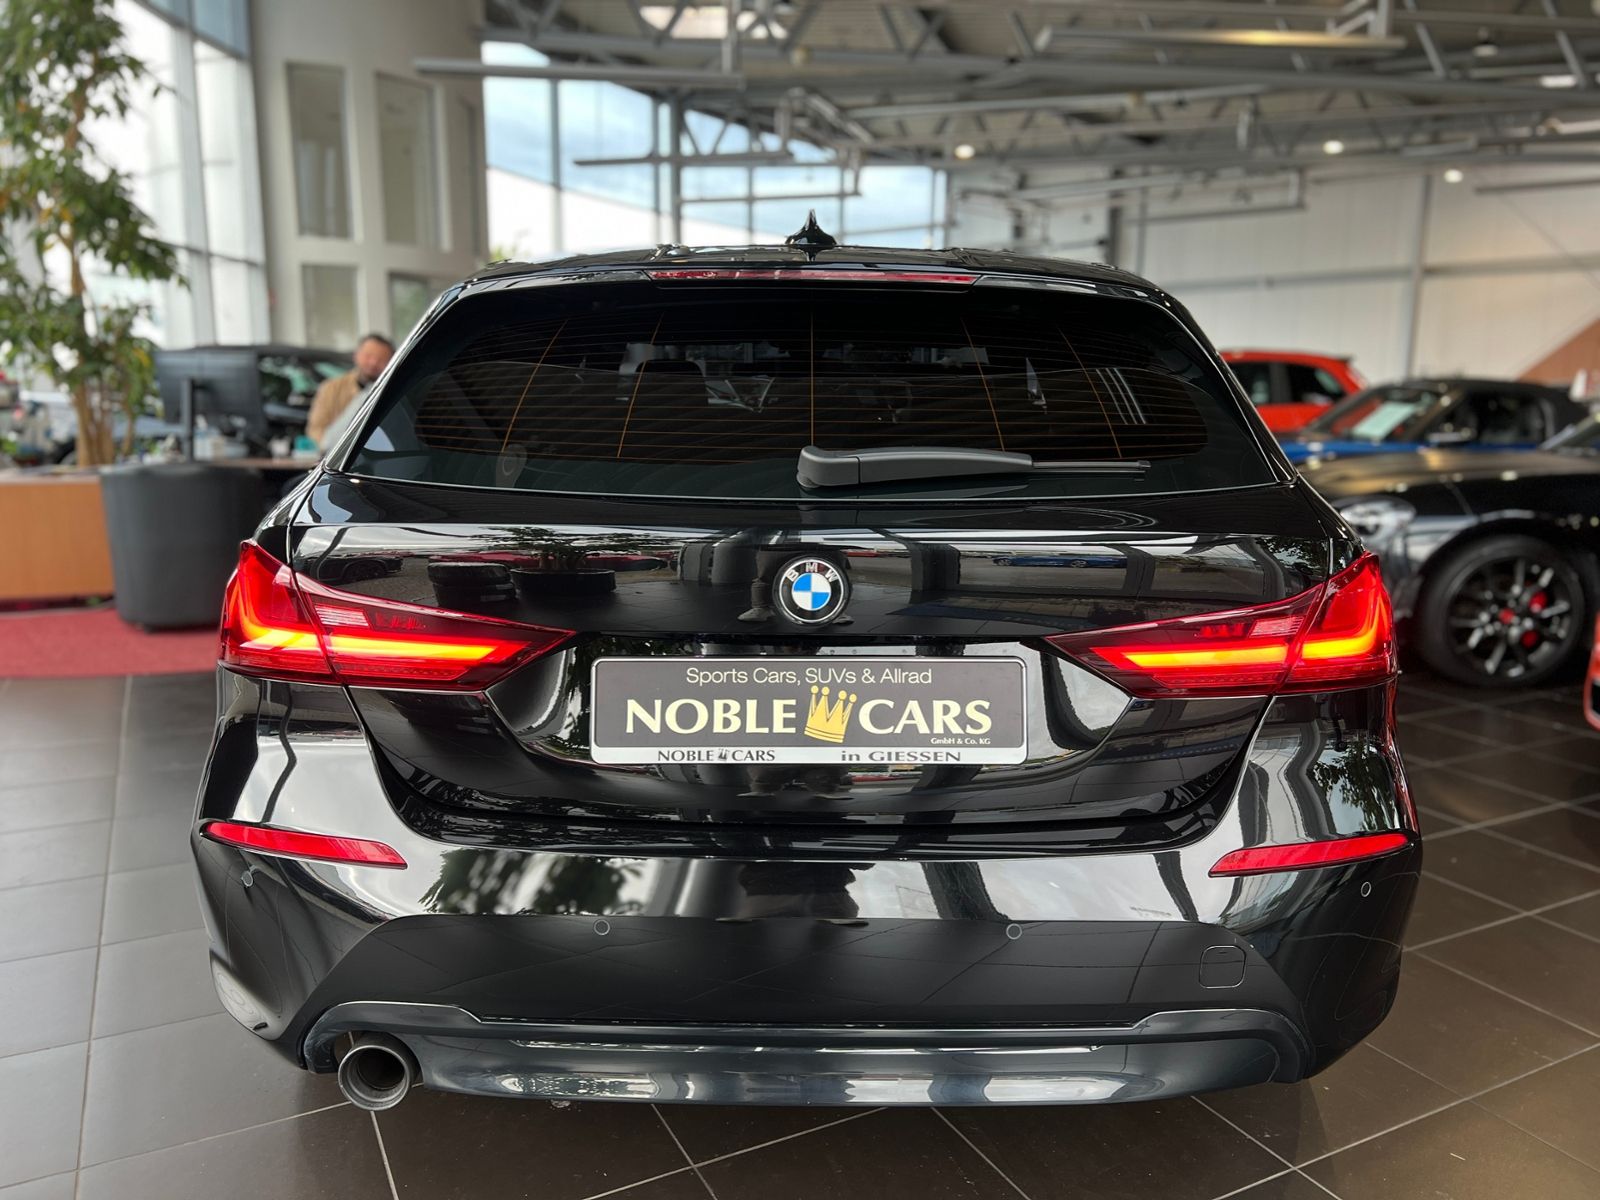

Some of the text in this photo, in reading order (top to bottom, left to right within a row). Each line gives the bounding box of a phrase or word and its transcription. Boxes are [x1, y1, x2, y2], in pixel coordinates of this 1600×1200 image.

[786, 561, 839, 583] BMW
[686, 667, 932, 687] Sports Cars, SUVs & Allrad
[625, 698, 992, 736] NOBLE CARS
[930, 736, 991, 745] GmbH & Co. KG
[657, 749, 961, 763] NOBLE CARS in GIESSEN
